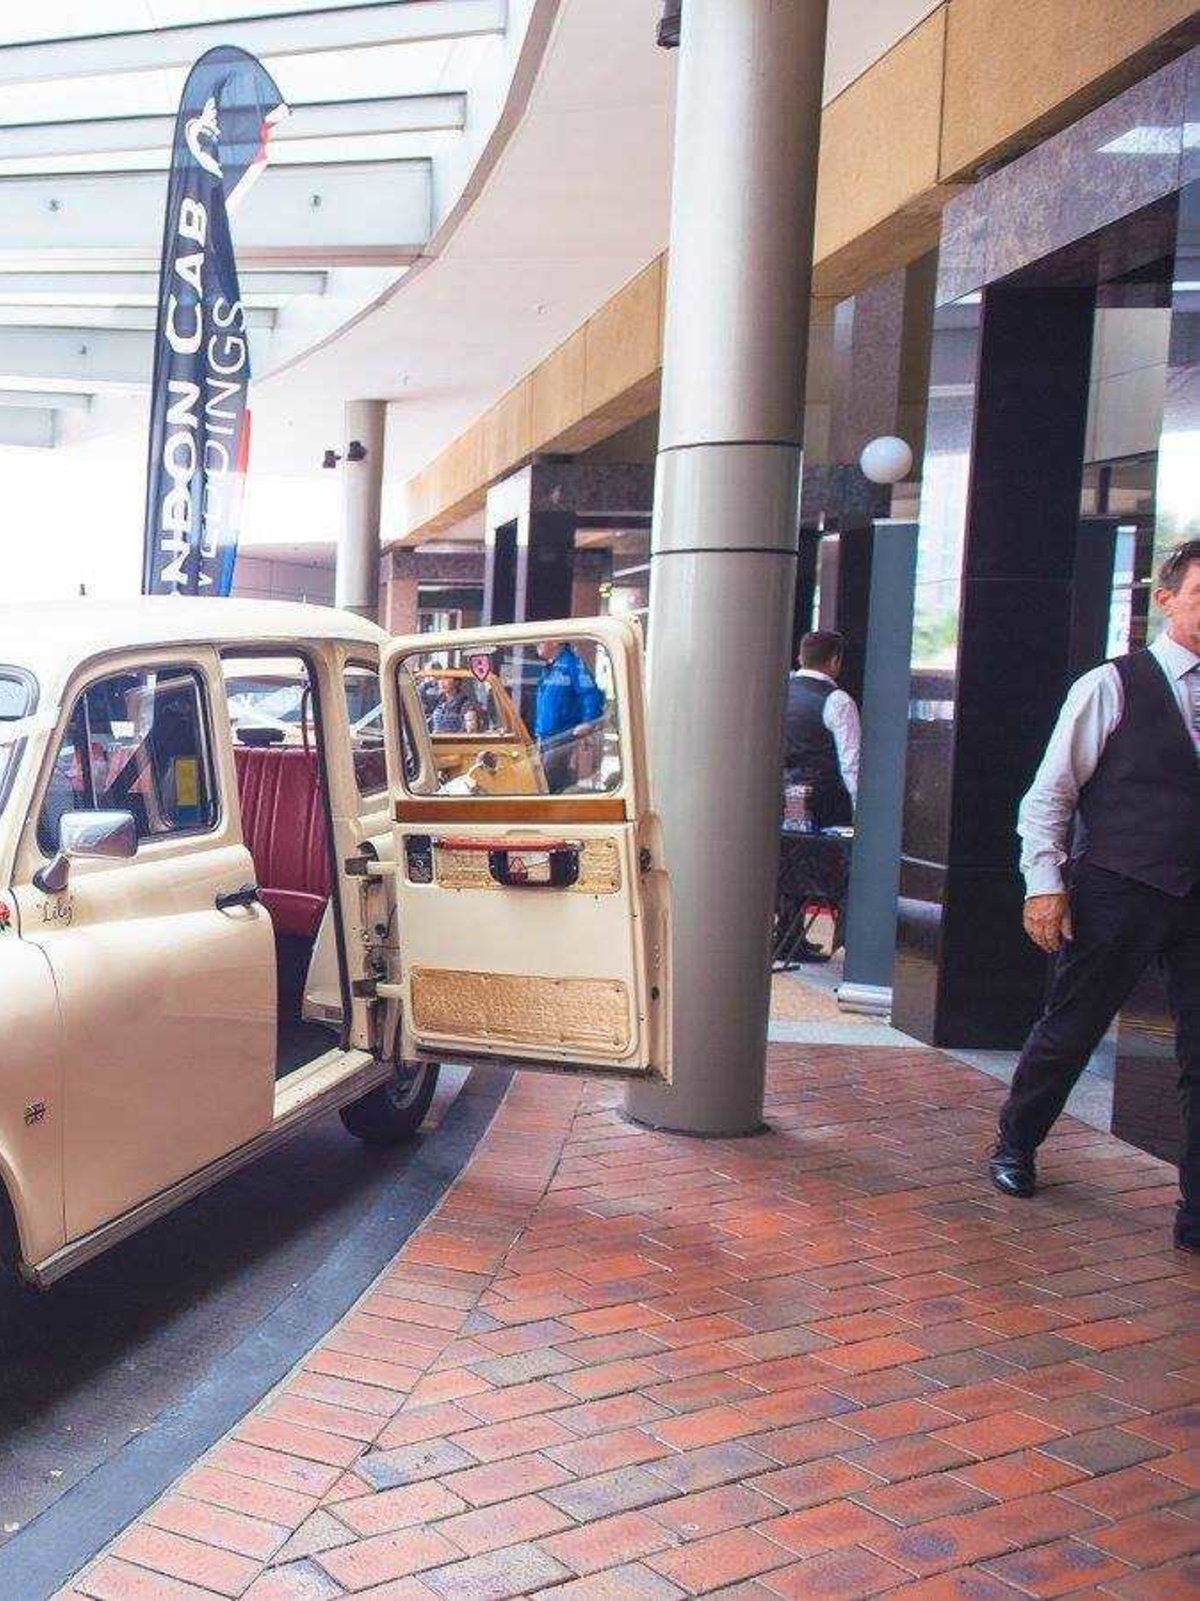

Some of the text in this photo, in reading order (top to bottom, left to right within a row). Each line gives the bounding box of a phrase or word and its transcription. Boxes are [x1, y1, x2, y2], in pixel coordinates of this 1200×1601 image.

[160, 197, 208, 595] NDON CAB
[198, 297, 247, 587] DINGS
